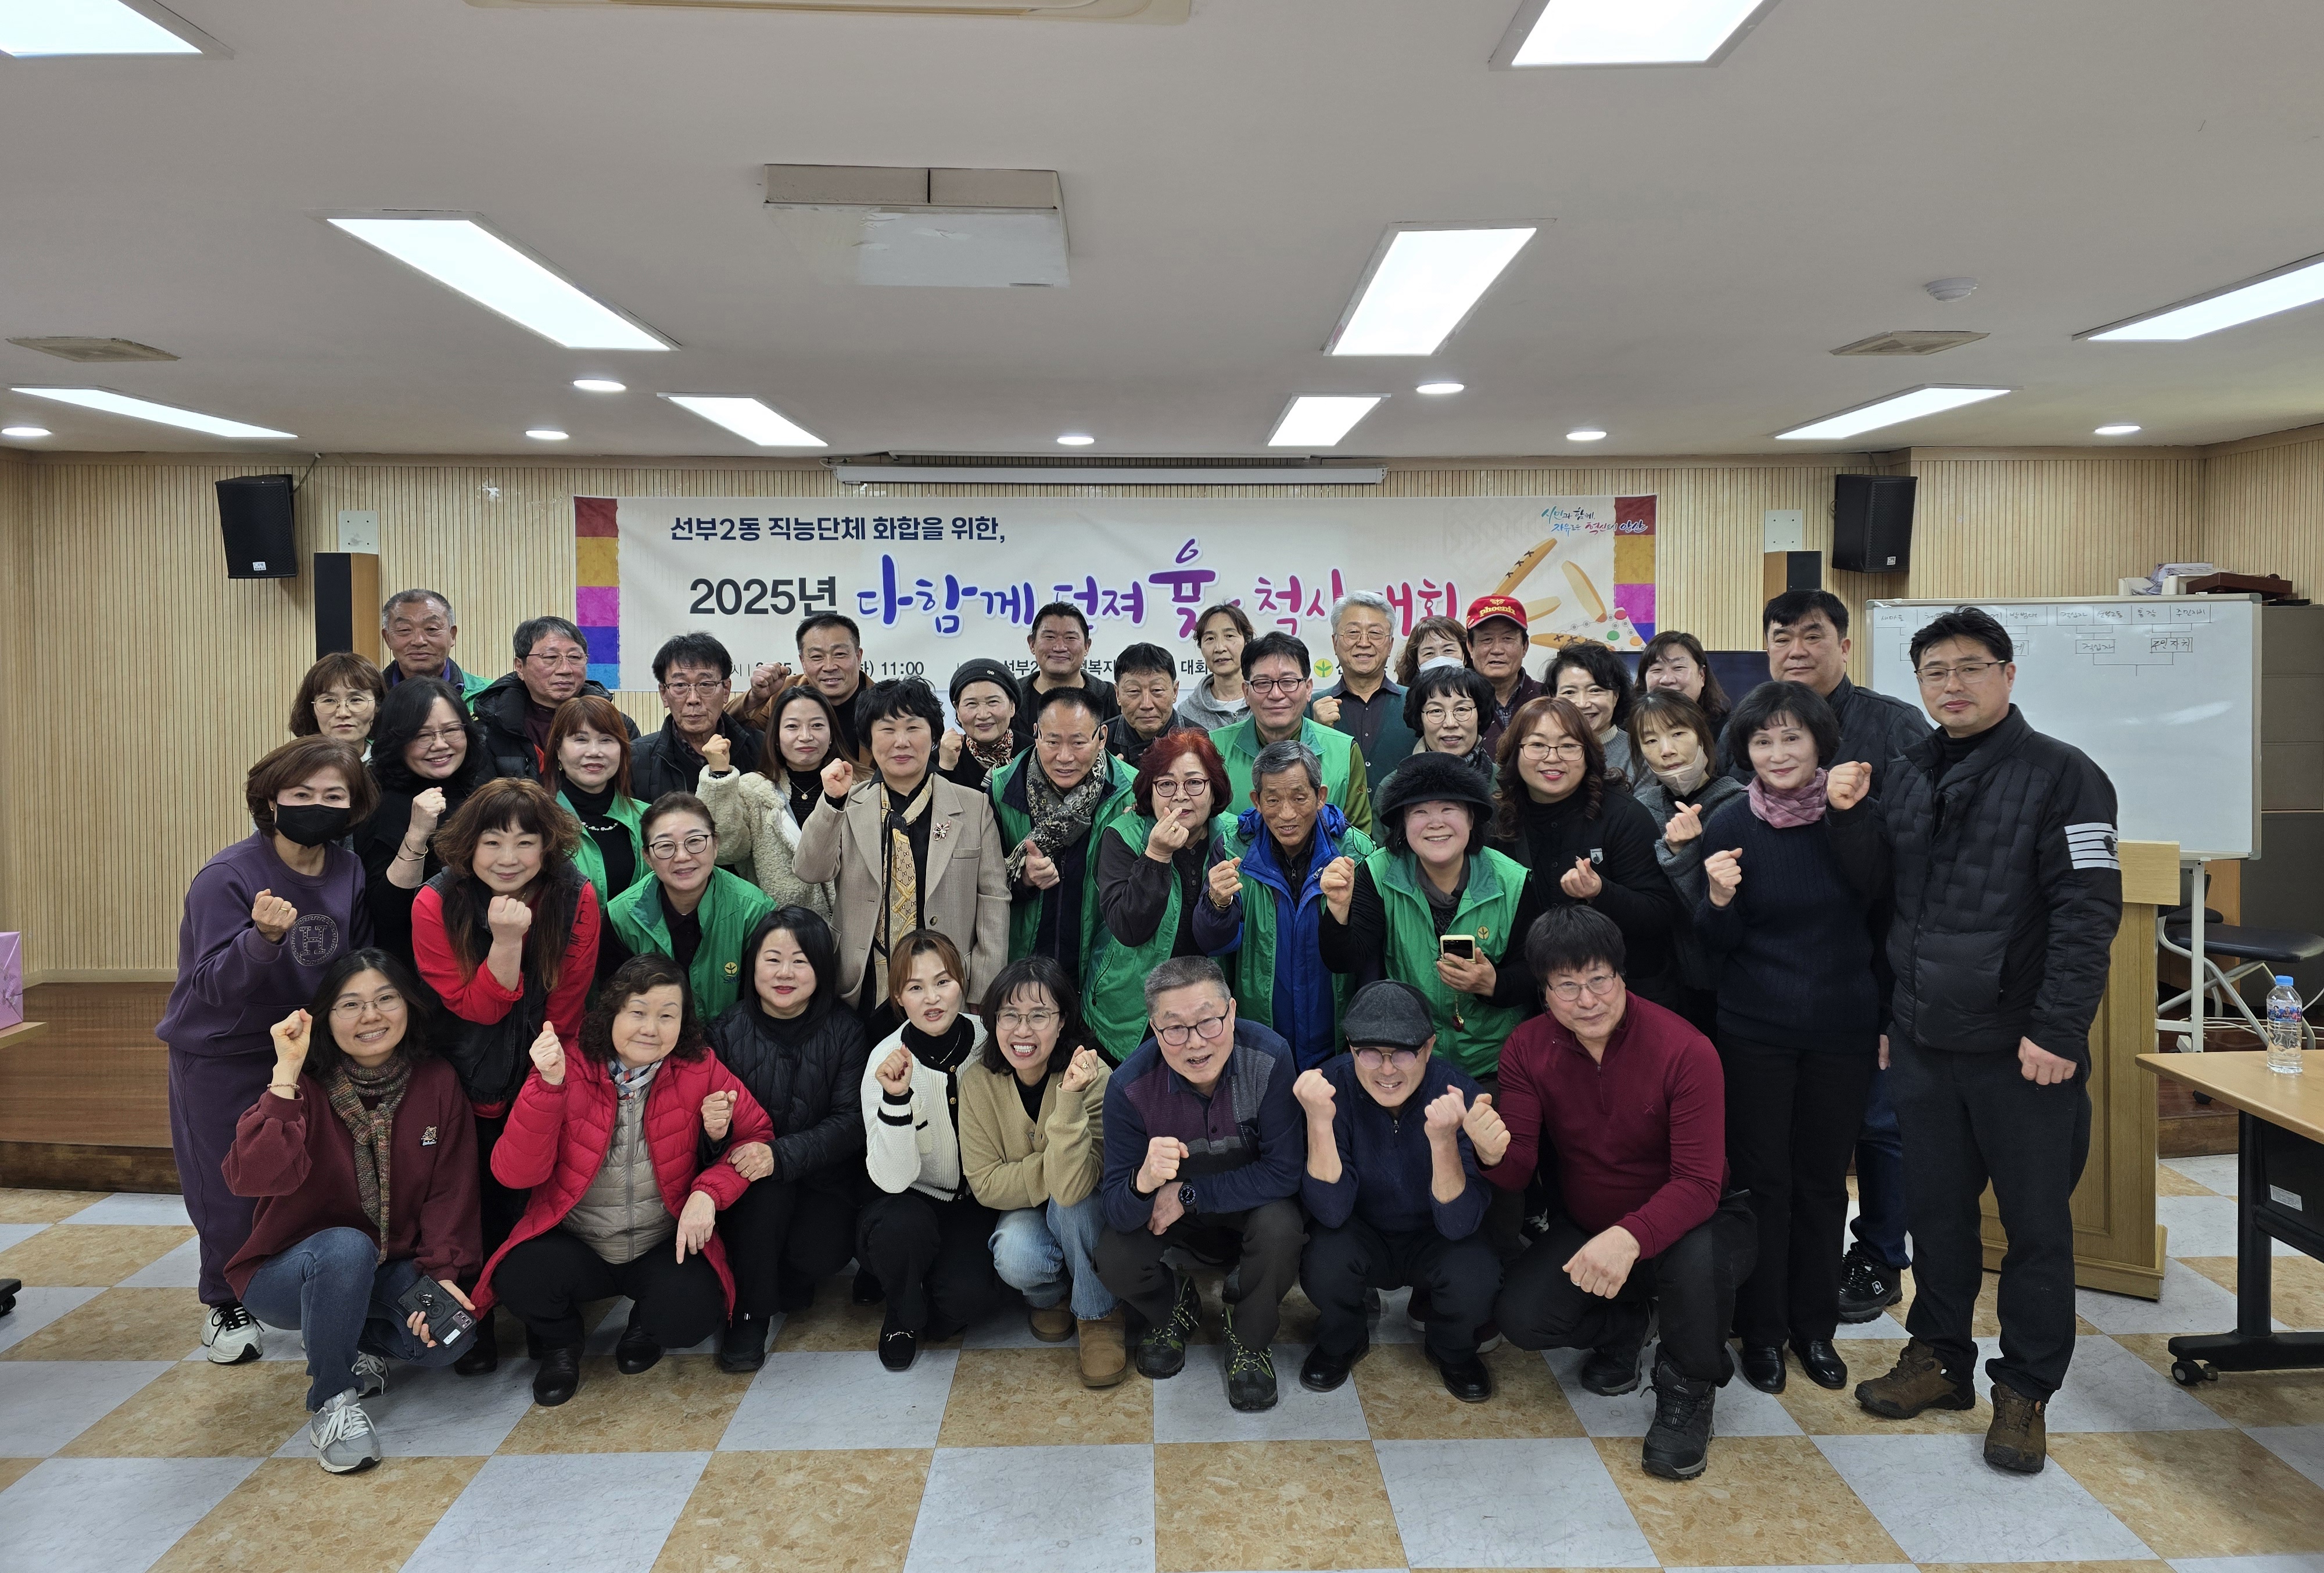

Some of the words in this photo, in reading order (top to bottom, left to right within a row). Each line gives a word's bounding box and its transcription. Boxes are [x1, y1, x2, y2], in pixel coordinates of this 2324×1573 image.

[1541, 505, 1572, 524] 시민과
[670, 516, 761, 541] 선부2동
[768, 516, 866, 541] 직능단체
[873, 516, 944, 540] 화합을
[951, 516, 1005, 543] 위한,
[1551, 523, 1581, 537] 자유로운
[1584, 522, 1618, 535] 혁신도시
[1619, 519, 1648, 533] 안산
[689, 576, 838, 616] 2025년
[856, 554, 1035, 634] 다함께
[881, 661, 924, 676] 11:00
